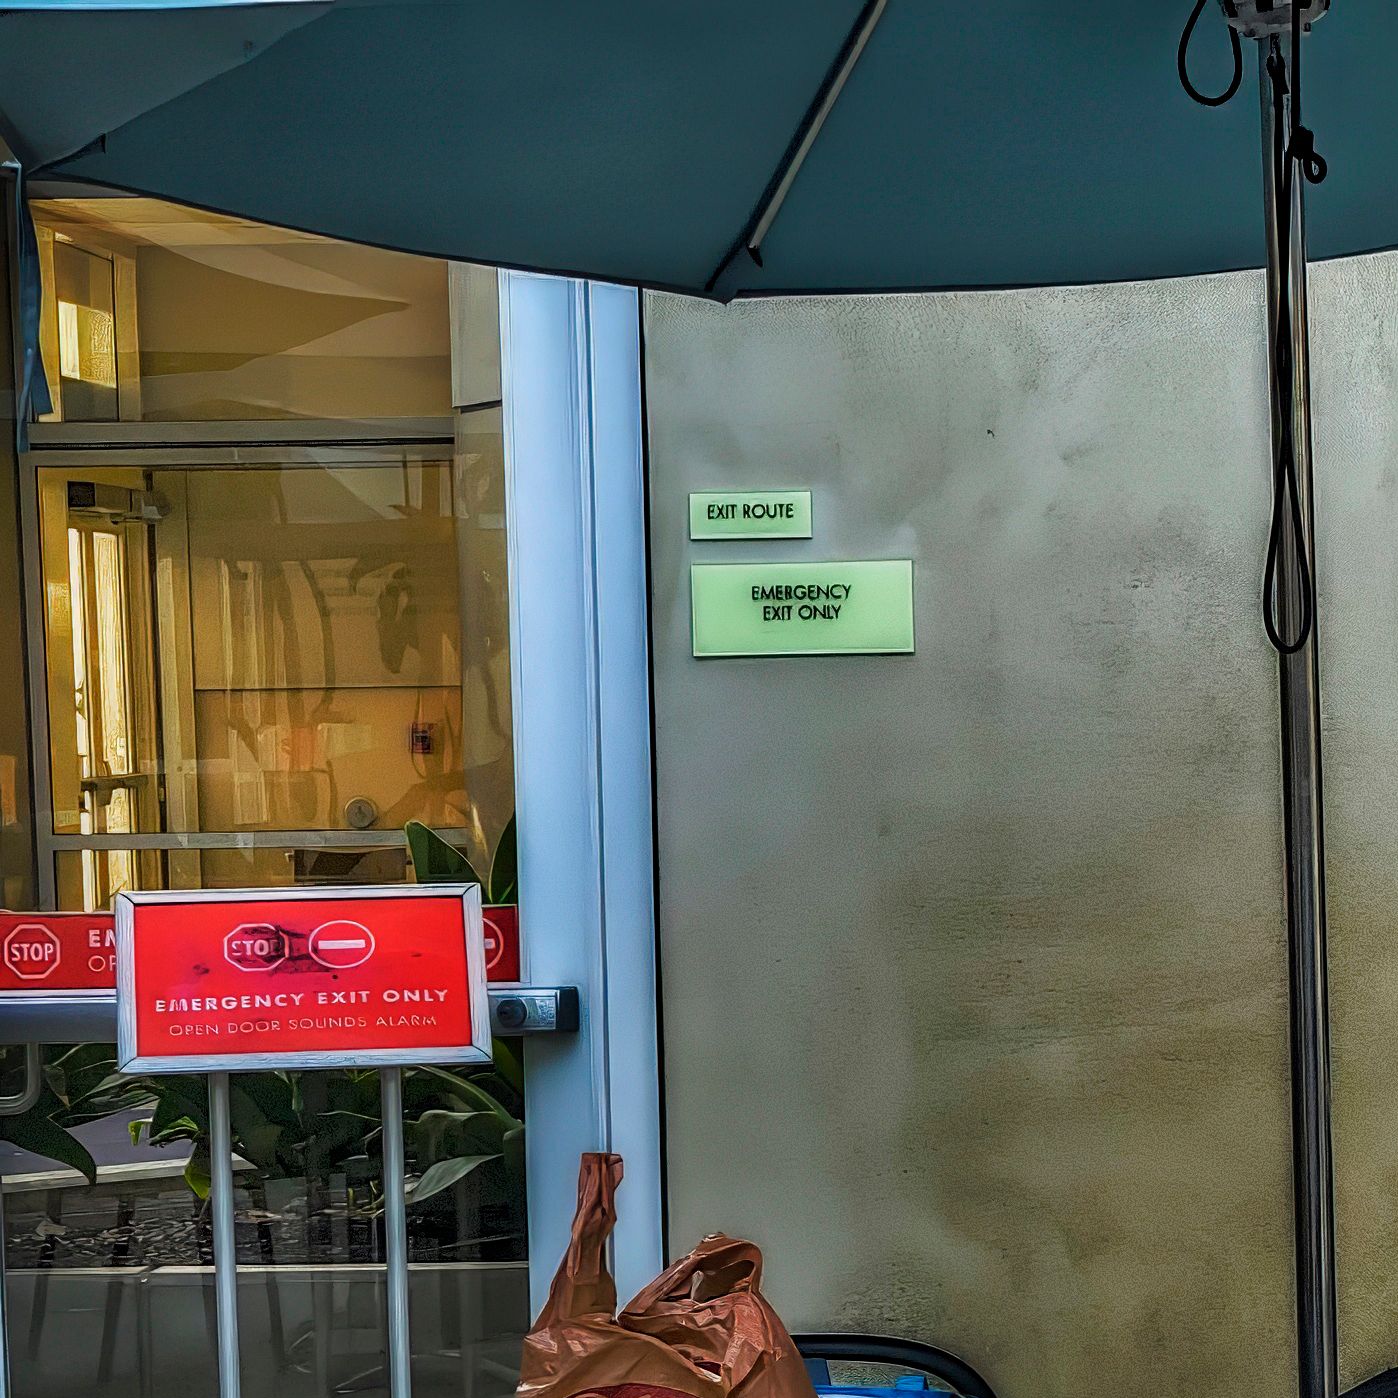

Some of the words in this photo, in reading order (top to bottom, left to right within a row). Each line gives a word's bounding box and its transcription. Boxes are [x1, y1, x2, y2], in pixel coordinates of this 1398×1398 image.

[707, 504, 737, 519] EXIT
[743, 503, 794, 519] ROUTE
[751, 584, 851, 601] EMERGENCY
[763, 606, 792, 621] EXIT
[798, 605, 841, 620] ONLY
[10, 943, 54, 961] STOP
[155, 993, 304, 1012] EMERGENCY
[317, 990, 370, 1005] EXIT
[382, 989, 448, 1003] ONLY
[169, 1024, 219, 1037] OPEN
[227, 1021, 281, 1034] DOOR
[288, 1016, 367, 1031] SOUNDS
[376, 1015, 437, 1027] ALARM
